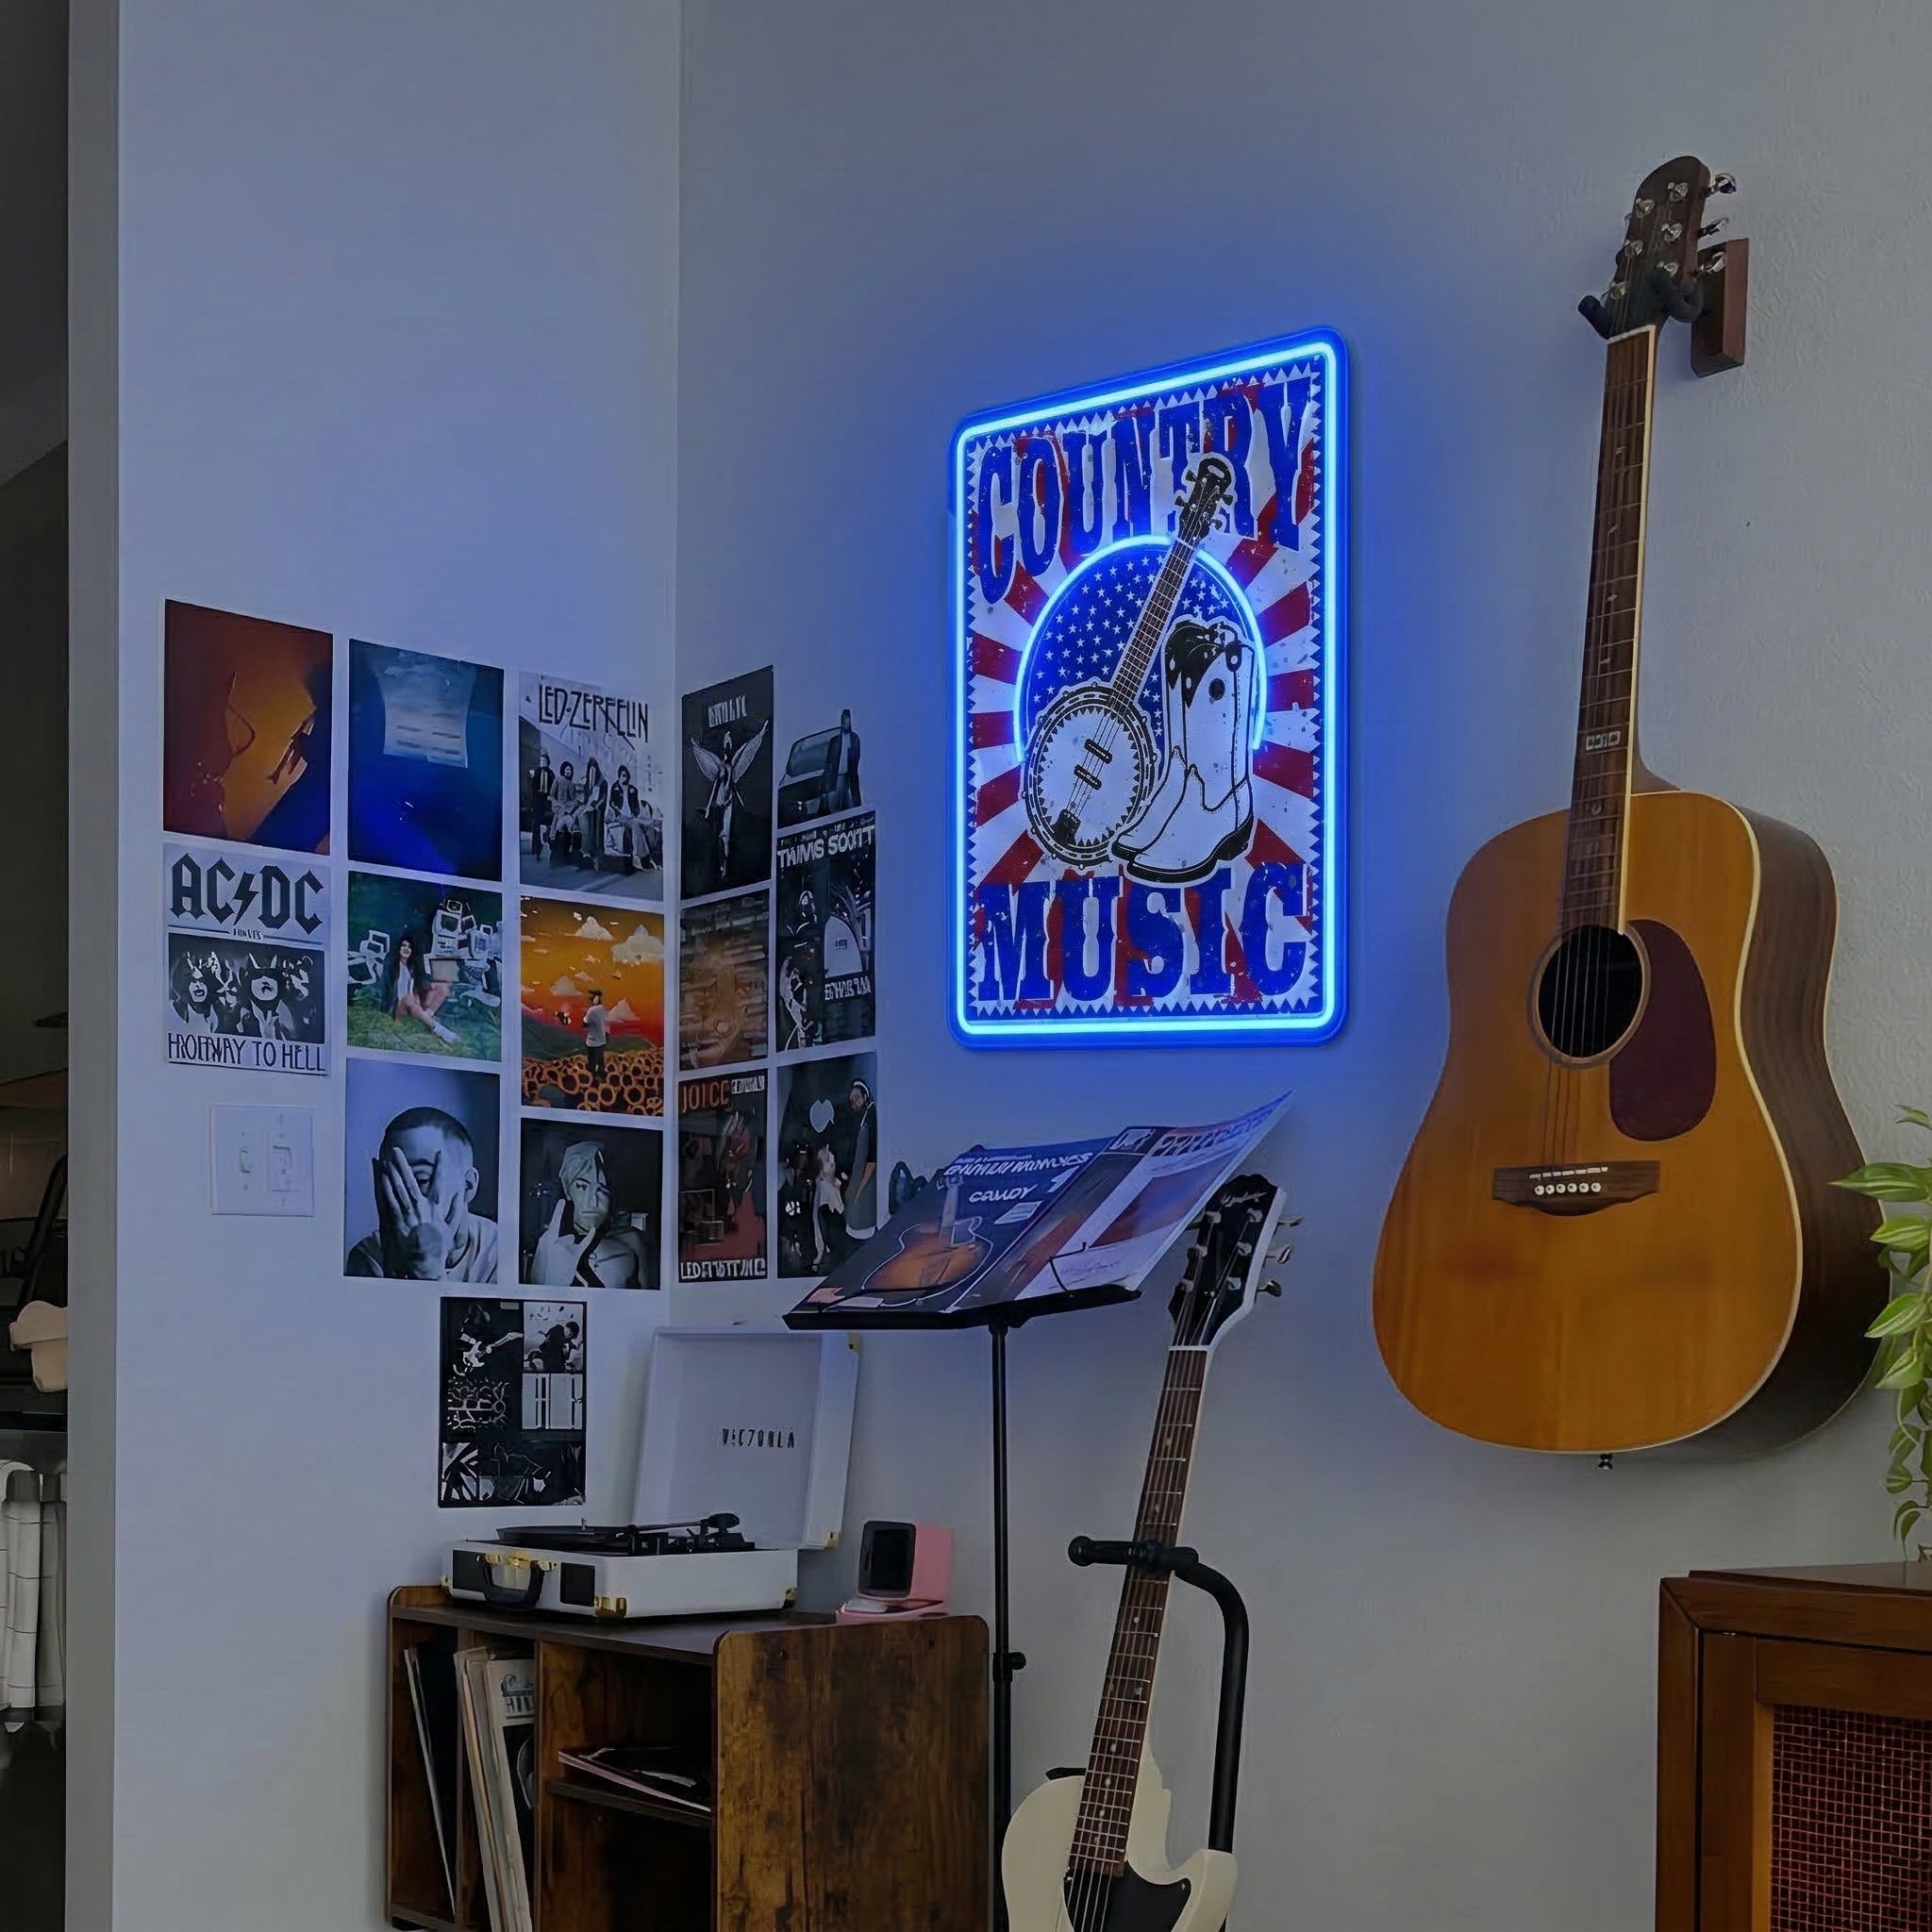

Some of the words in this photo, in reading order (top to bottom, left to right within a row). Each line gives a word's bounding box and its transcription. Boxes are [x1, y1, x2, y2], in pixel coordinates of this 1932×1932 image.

[978, 375, 1312, 605] COUNTRY
[974, 862, 1307, 1002] MUSIC
[252, 1041, 276, 1067] TO
[283, 1043, 326, 1072] HELL
